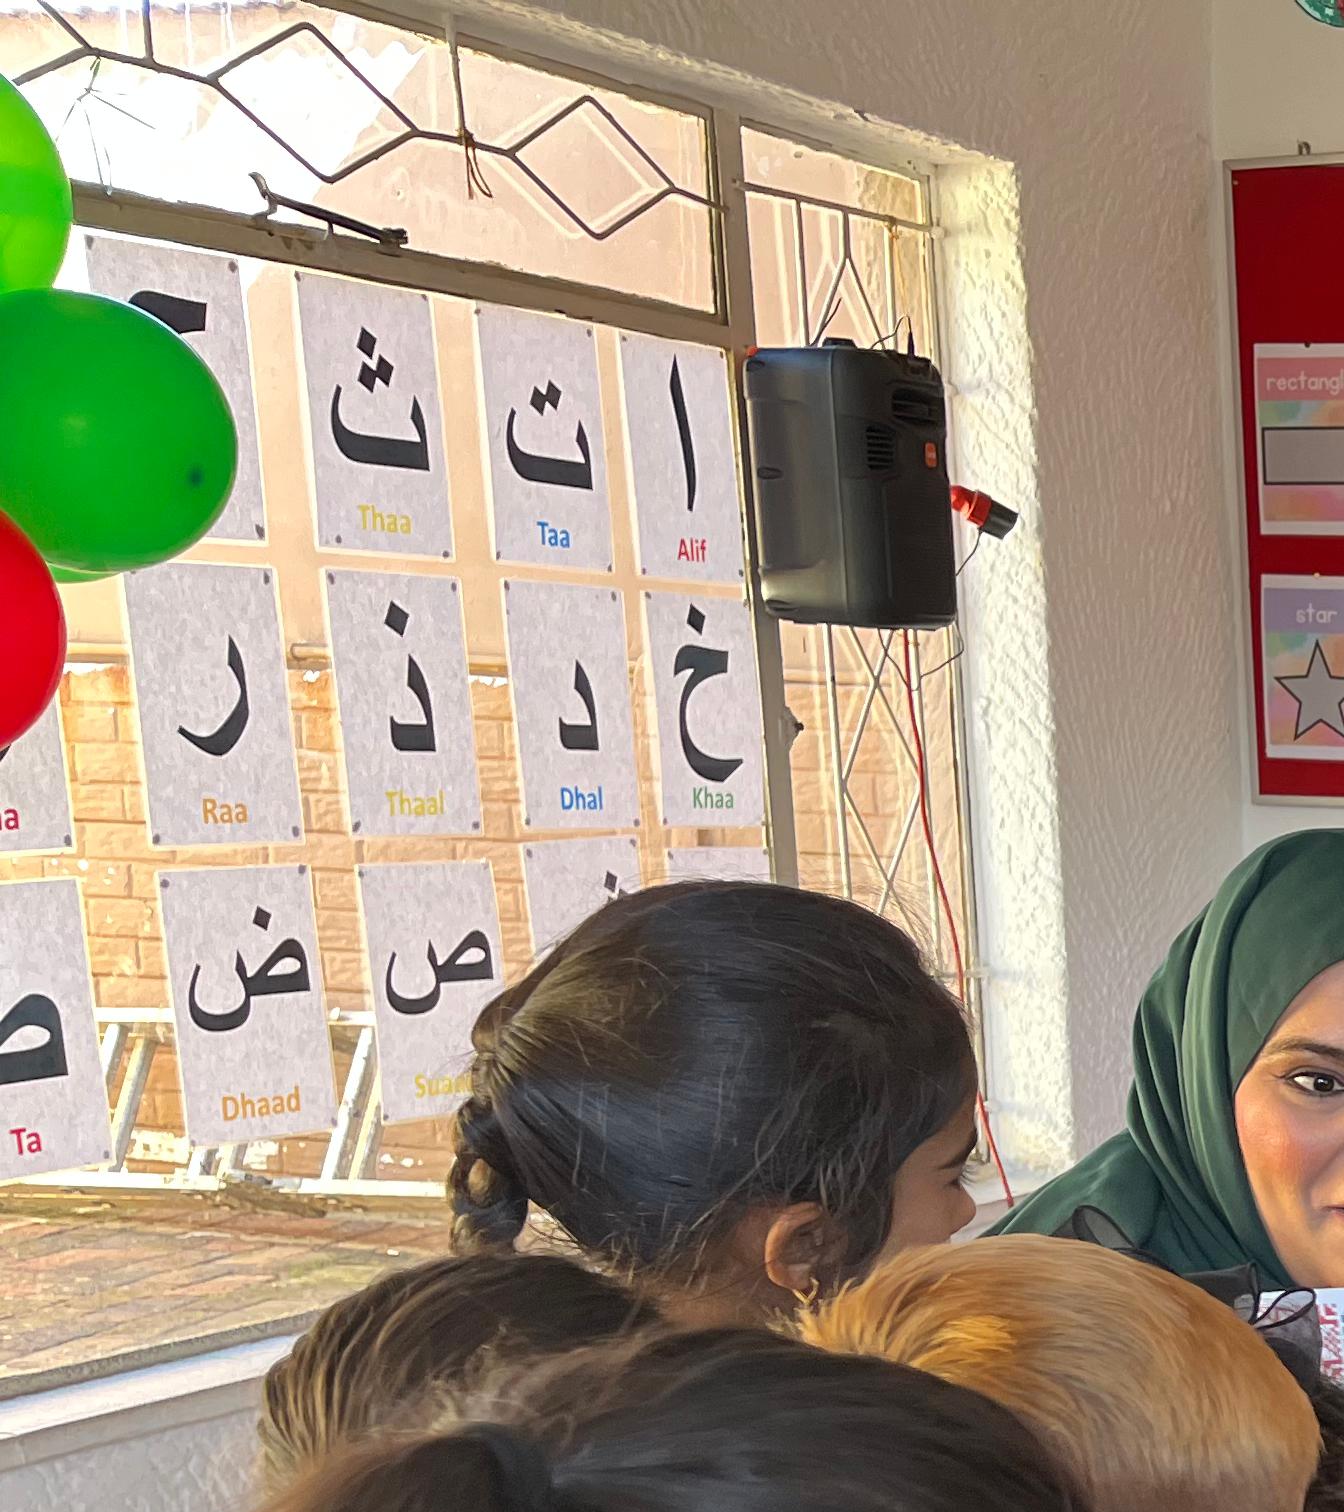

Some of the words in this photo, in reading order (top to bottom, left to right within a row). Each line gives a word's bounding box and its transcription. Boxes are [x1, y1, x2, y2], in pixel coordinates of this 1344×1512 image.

[331, 326, 431, 471] ث
[505, 379, 594, 491] ت
[669, 354, 697, 511] ا
[357, 505, 412, 535] Thaa
[537, 521, 571, 549] Taa
[678, 537, 707, 564] Alif
[1296, 603, 1337, 623] star
[384, 600, 436, 753] ذ
[673, 603, 744, 783] خ
[177, 635, 250, 757] ر
[558, 660, 599, 751] د
[202, 799, 248, 825] Raa
[386, 790, 445, 818] Thaal
[560, 786, 603, 811] Dhal
[692, 786, 735, 811] Khaa
[187, 906, 311, 1033] ض
[384, 930, 494, 1016] ص
[221, 1087, 302, 1121] Dhaad
[10, 1127, 42, 1156] Ta
